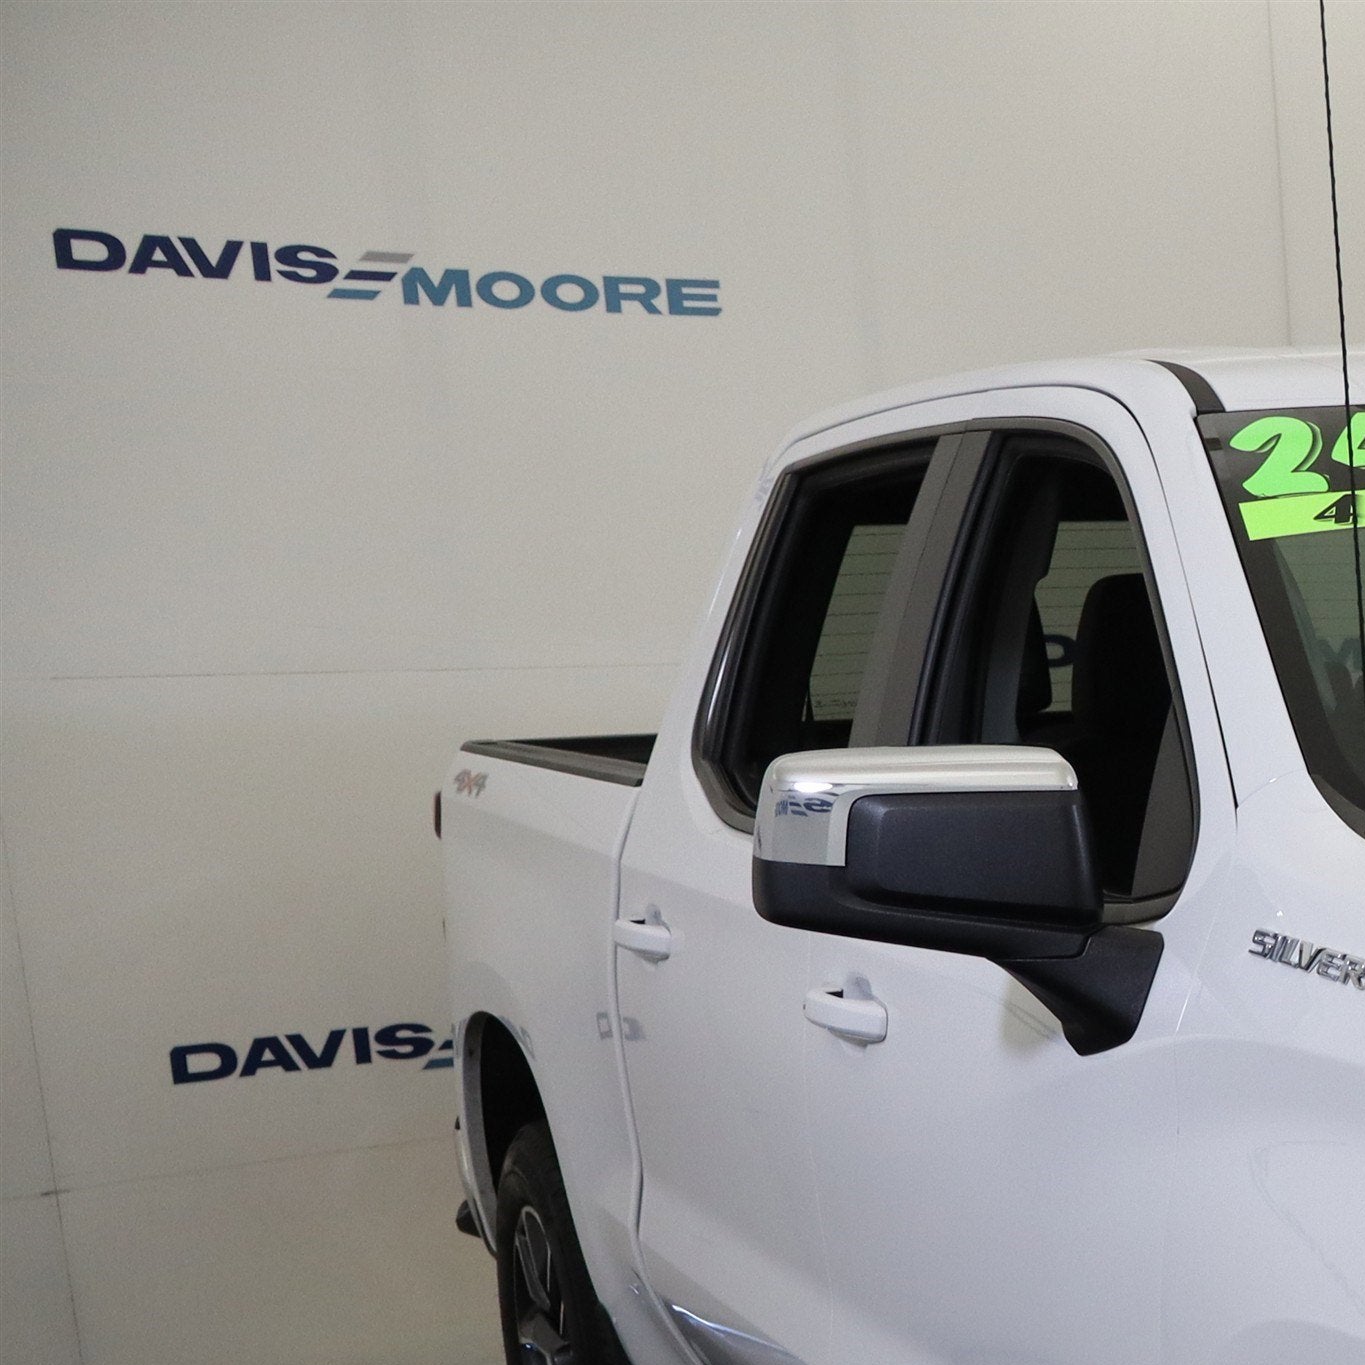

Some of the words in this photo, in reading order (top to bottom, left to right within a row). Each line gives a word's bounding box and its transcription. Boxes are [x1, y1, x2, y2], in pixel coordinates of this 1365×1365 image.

[51, 228, 340, 285] DAVIS
[400, 266, 723, 316] MOORE
[169, 1023, 435, 1085] DAVIS
